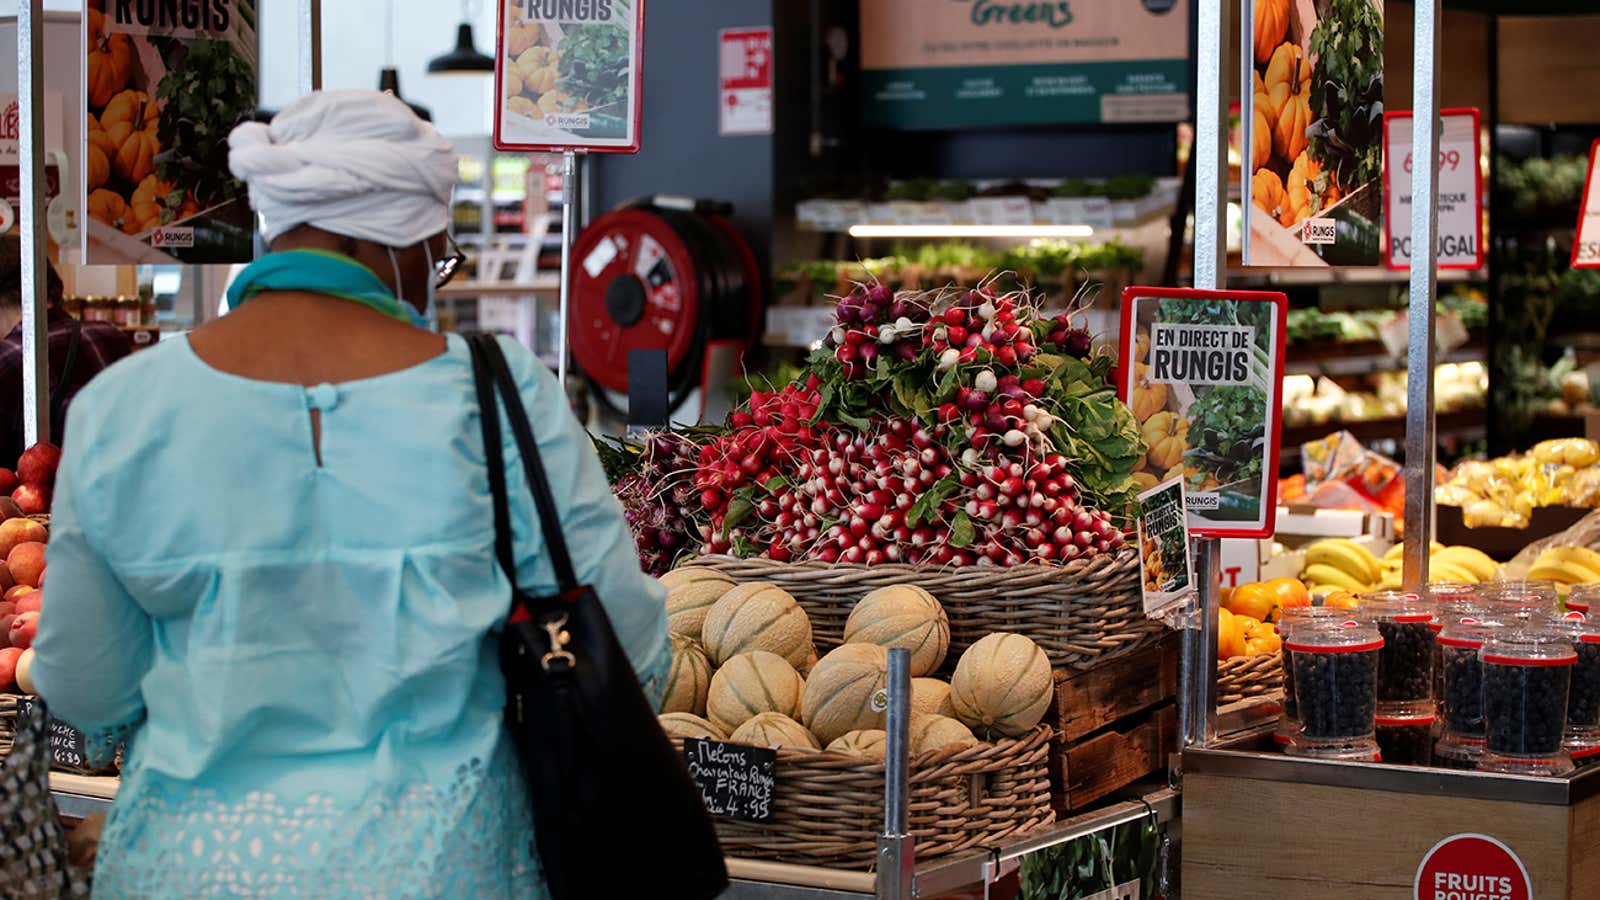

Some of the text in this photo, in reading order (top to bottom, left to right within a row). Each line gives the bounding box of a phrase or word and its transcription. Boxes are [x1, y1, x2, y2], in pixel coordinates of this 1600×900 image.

[115, 0, 231, 32] RUNGIS
[527, 0, 612, 21] RUNGIS
[971, 0, 1073, 28] Greens
[165, 232, 193, 241] RUNGIS
[1156, 329, 1249, 348] EN DIRECT DE
[1154, 350, 1249, 382] RUNGIS
[1185, 496, 1218, 506] RUNGIS
[1147, 512, 1178, 539] RUNGIS
[698, 741, 747, 766] Melons
[715, 778, 771, 802] FRANCE
[1434, 872, 1513, 894] FRUITS
